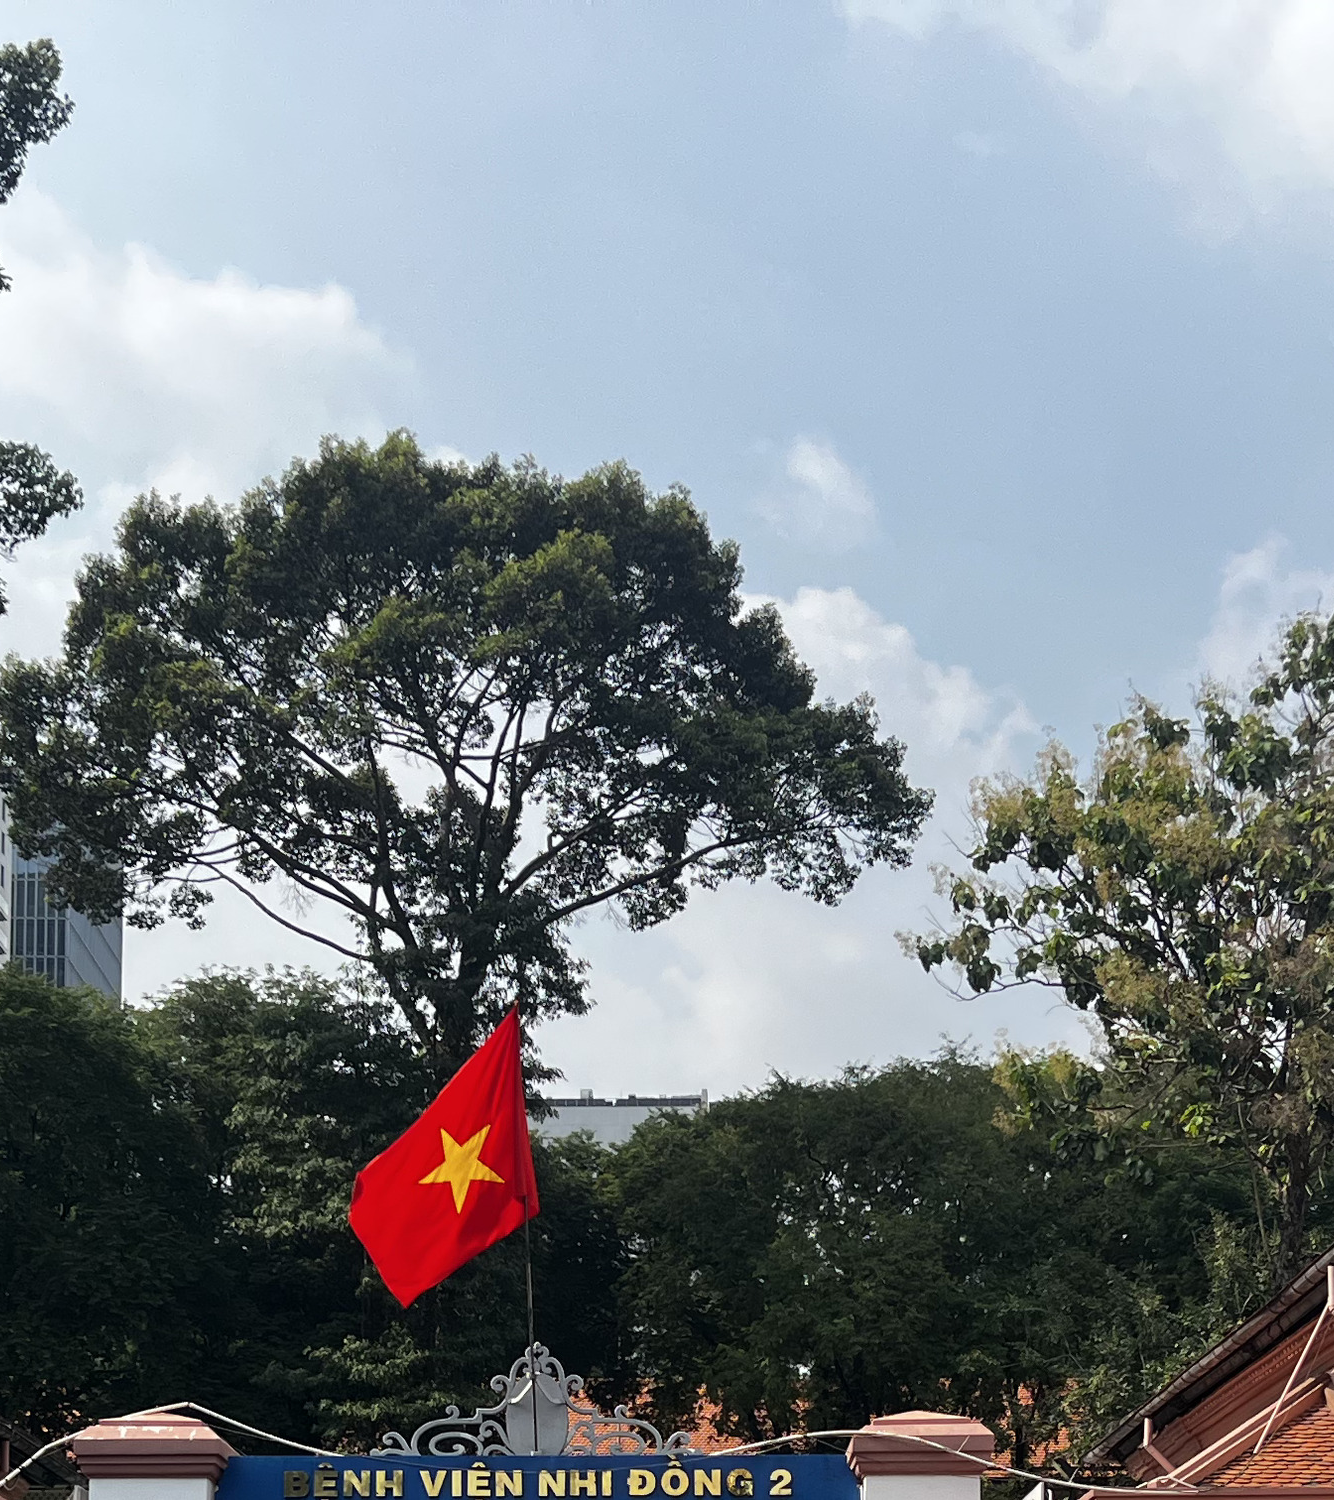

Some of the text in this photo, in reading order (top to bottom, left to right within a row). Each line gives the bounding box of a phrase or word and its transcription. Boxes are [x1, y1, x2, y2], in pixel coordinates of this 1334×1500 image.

[538, 1469, 614, 1498] NHI
[626, 1454, 754, 1498] ĐỒNG
[768, 1468, 793, 1497] 2
